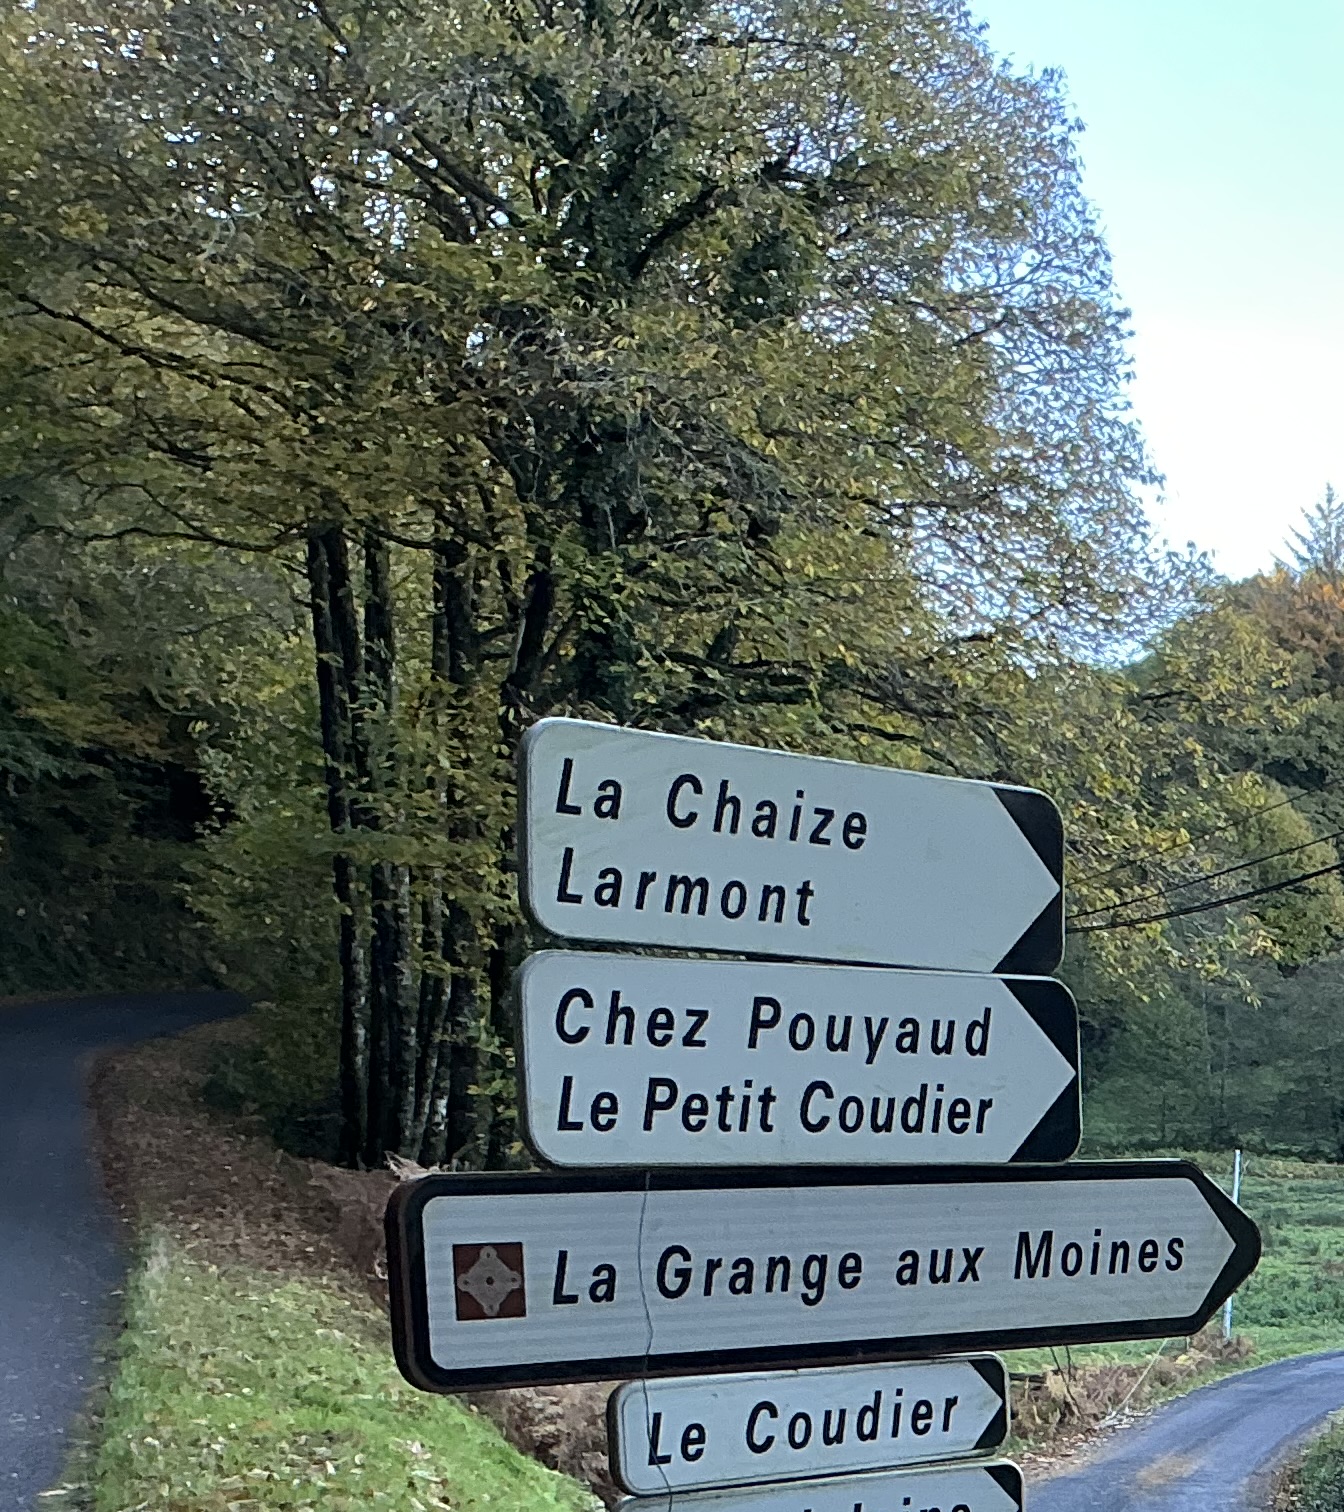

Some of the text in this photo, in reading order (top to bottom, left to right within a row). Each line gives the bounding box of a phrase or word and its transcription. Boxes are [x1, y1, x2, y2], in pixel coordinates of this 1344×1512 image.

[555, 758, 868, 850] La Chaize
[556, 847, 815, 925] Larmont
[555, 988, 991, 1064] Chez Pouyaud
[557, 1077, 993, 1135] Le Petit Coudier
[553, 1230, 1186, 1306] La Grange aux Moines
[648, 1388, 959, 1466] Le Coudier
